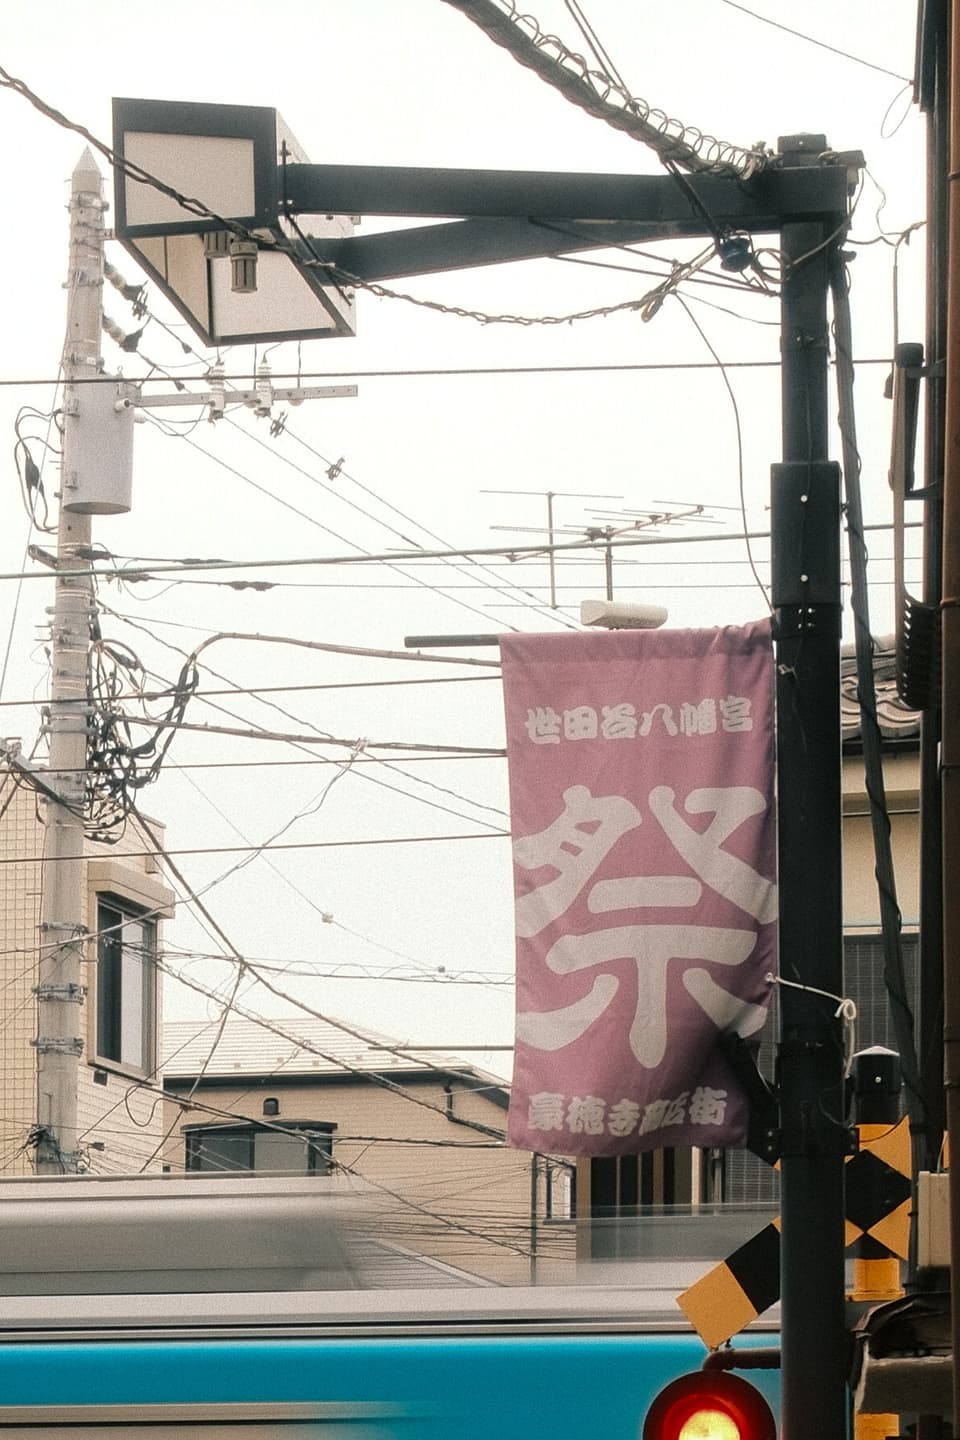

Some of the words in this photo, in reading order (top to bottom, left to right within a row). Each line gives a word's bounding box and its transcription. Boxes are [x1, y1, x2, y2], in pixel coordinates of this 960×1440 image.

[524, 695, 753, 745] 世田谷八幡宮
[512, 785, 778, 1069] 祭
